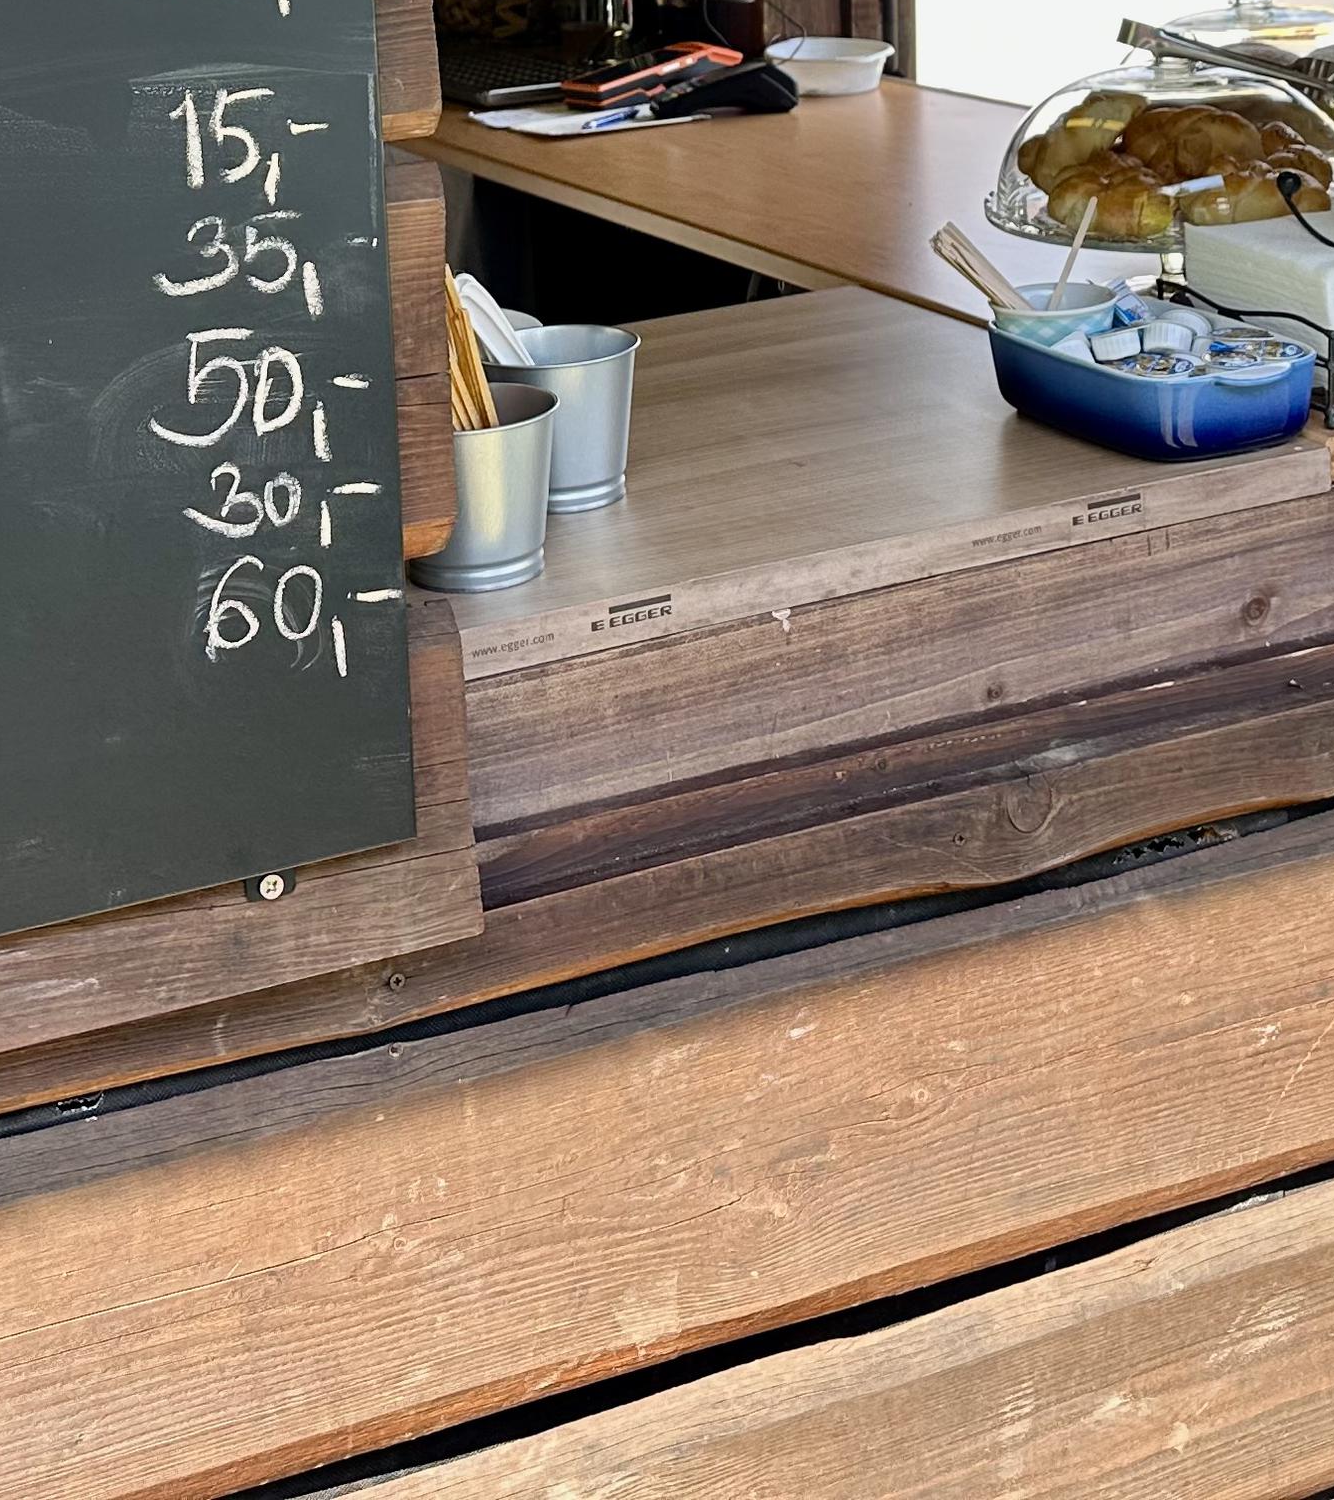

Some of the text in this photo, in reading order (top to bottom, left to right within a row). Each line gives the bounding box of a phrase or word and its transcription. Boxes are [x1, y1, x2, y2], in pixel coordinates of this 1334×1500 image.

[167, 88, 331, 205] 15,-
[148, 326, 373, 463] 50,-
[181, 460, 383, 548] 30,-
[1087, 502, 1143, 523] EGGER
[971, 524, 1043, 547] www.egger.com
[203, 553, 404, 679] 60,-
[471, 631, 555, 658] www.egger.com
[609, 604, 673, 628] EGGER
